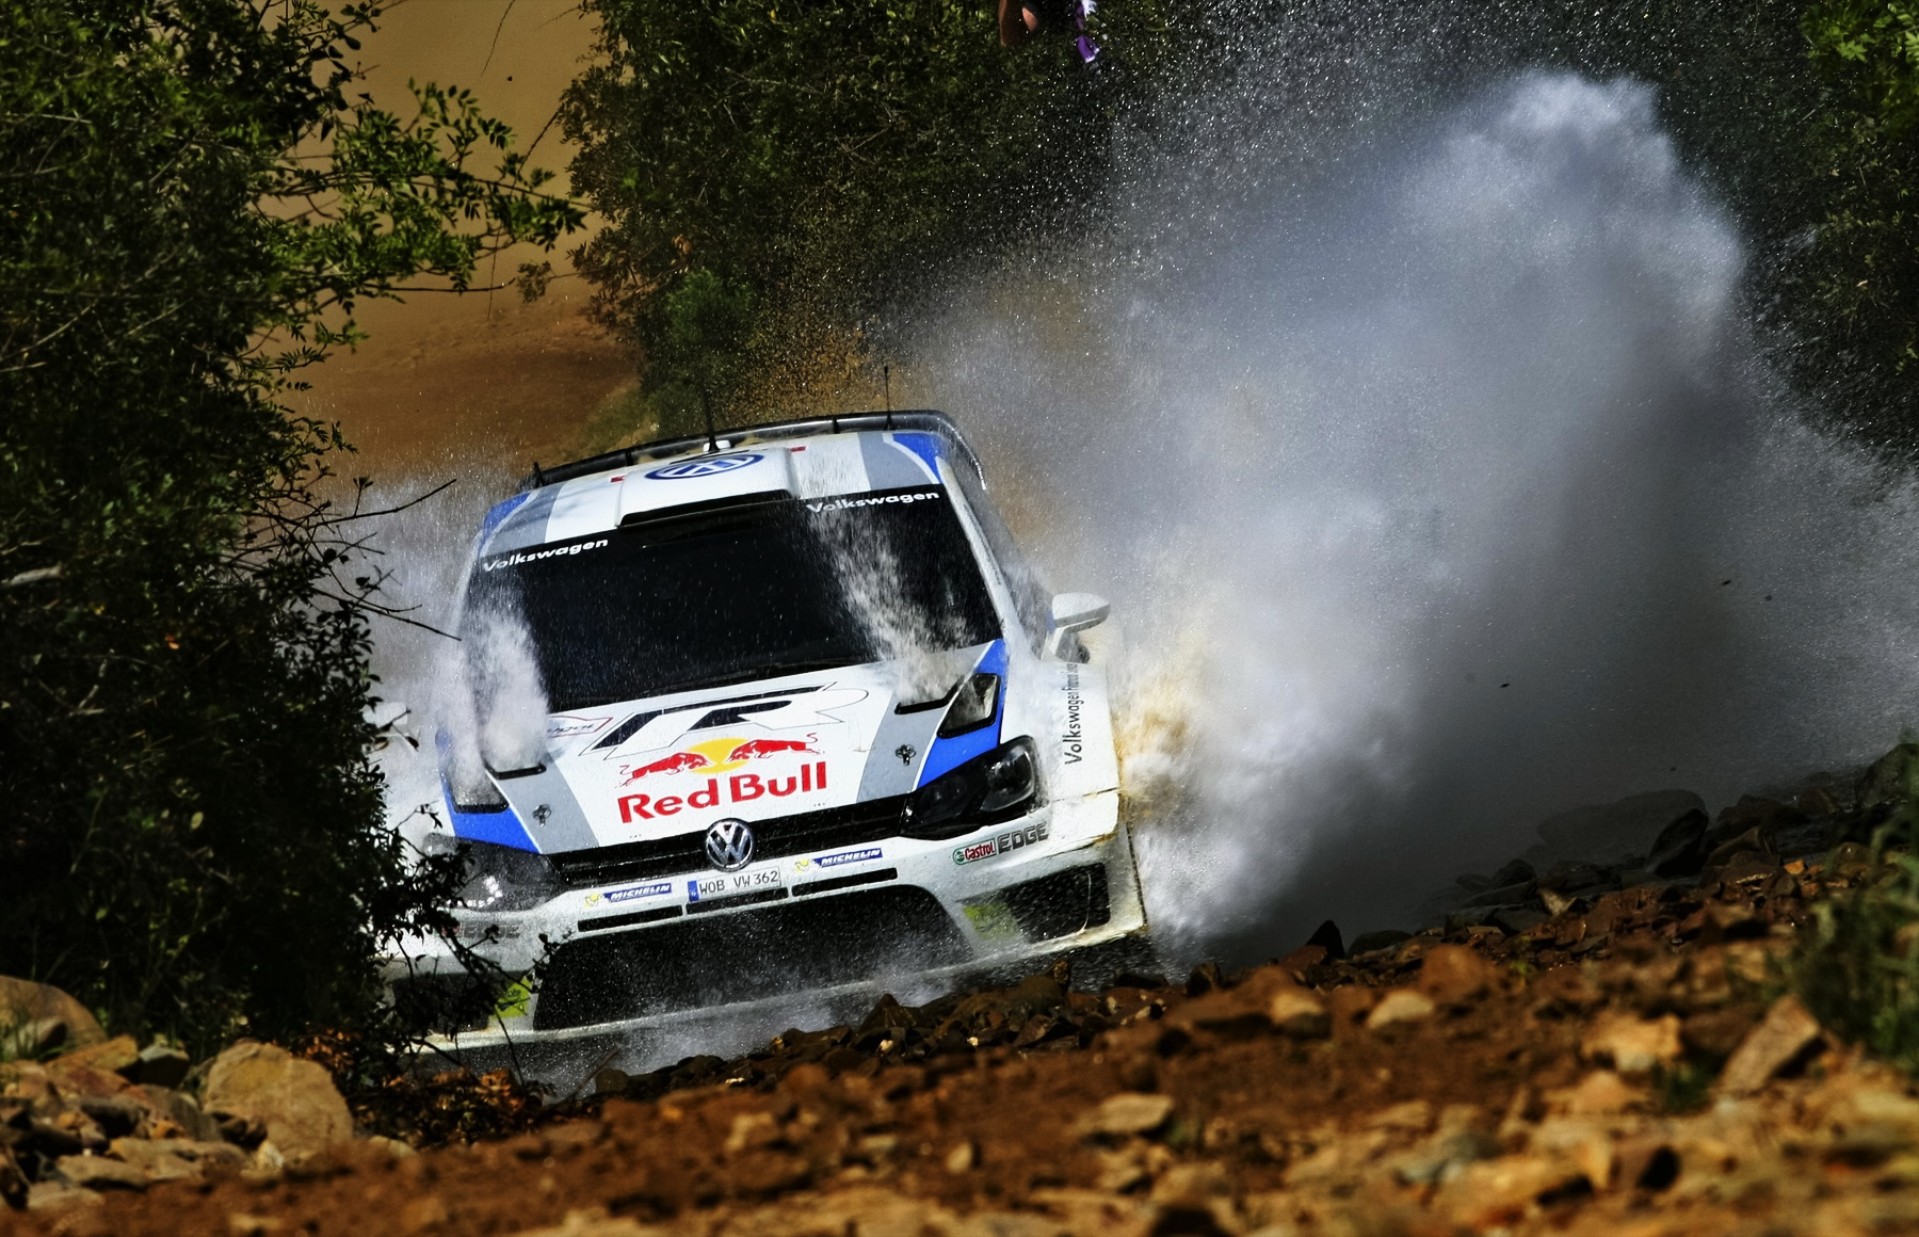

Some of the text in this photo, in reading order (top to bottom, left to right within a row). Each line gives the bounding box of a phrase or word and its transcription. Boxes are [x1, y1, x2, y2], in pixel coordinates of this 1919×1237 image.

[806, 492, 940, 514] Volkswagen
[483, 539, 609, 572] Volkswagen
[1061, 690, 1084, 765] Volkswagen
[617, 761, 827, 824] Red Bull
[964, 821, 1050, 860] Castrol EDGE
[821, 849, 881, 867] MICHELIN
[609, 883, 671, 901] MICHELIN
[699, 879, 725, 895] WOB
[733, 875, 751, 888] VW
[754, 870, 779, 885] 362
